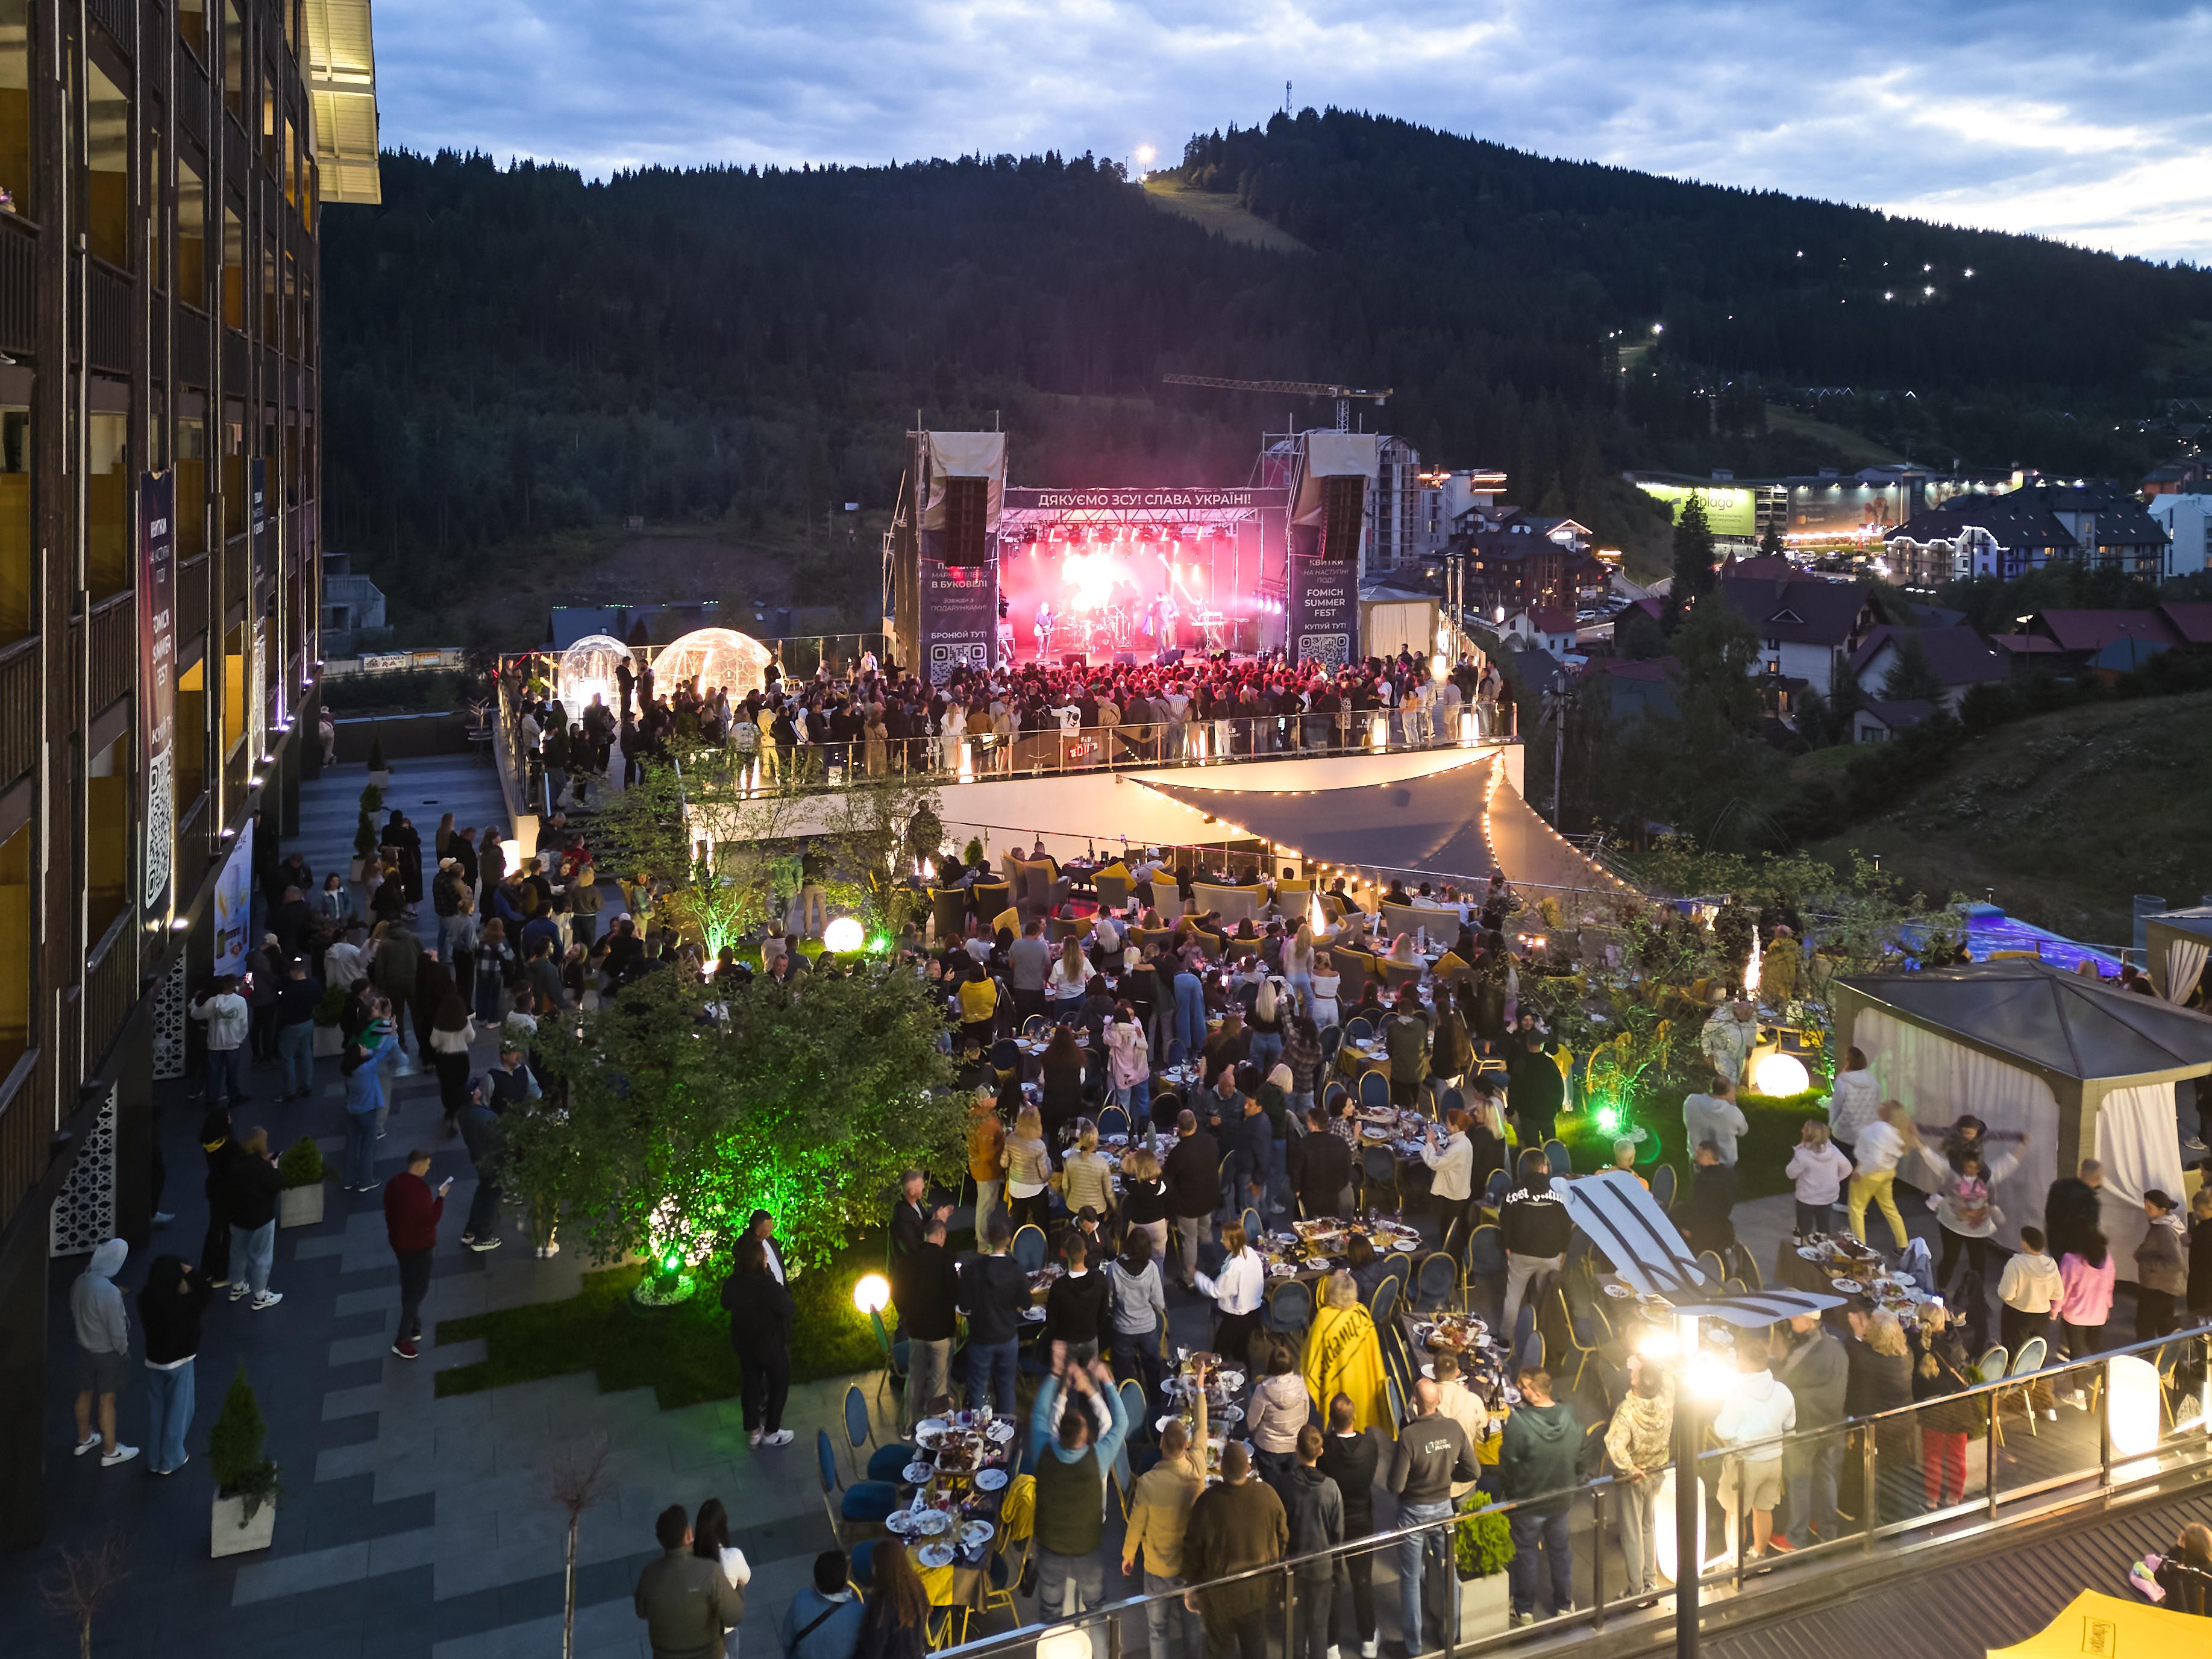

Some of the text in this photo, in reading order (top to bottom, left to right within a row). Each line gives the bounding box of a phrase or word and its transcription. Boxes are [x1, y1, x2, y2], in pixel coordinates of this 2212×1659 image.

[1038, 493, 1251, 507] ДЯКУЄМО ЗСУ! СЛАВА УКРАЇНІ!
[940, 580, 988, 588] БУКОВЕЛІ
[1307, 588, 1344, 597] FOMICH
[1305, 598, 1346, 607] SUMMER
[931, 630, 968, 639] БРОНЮЙ
